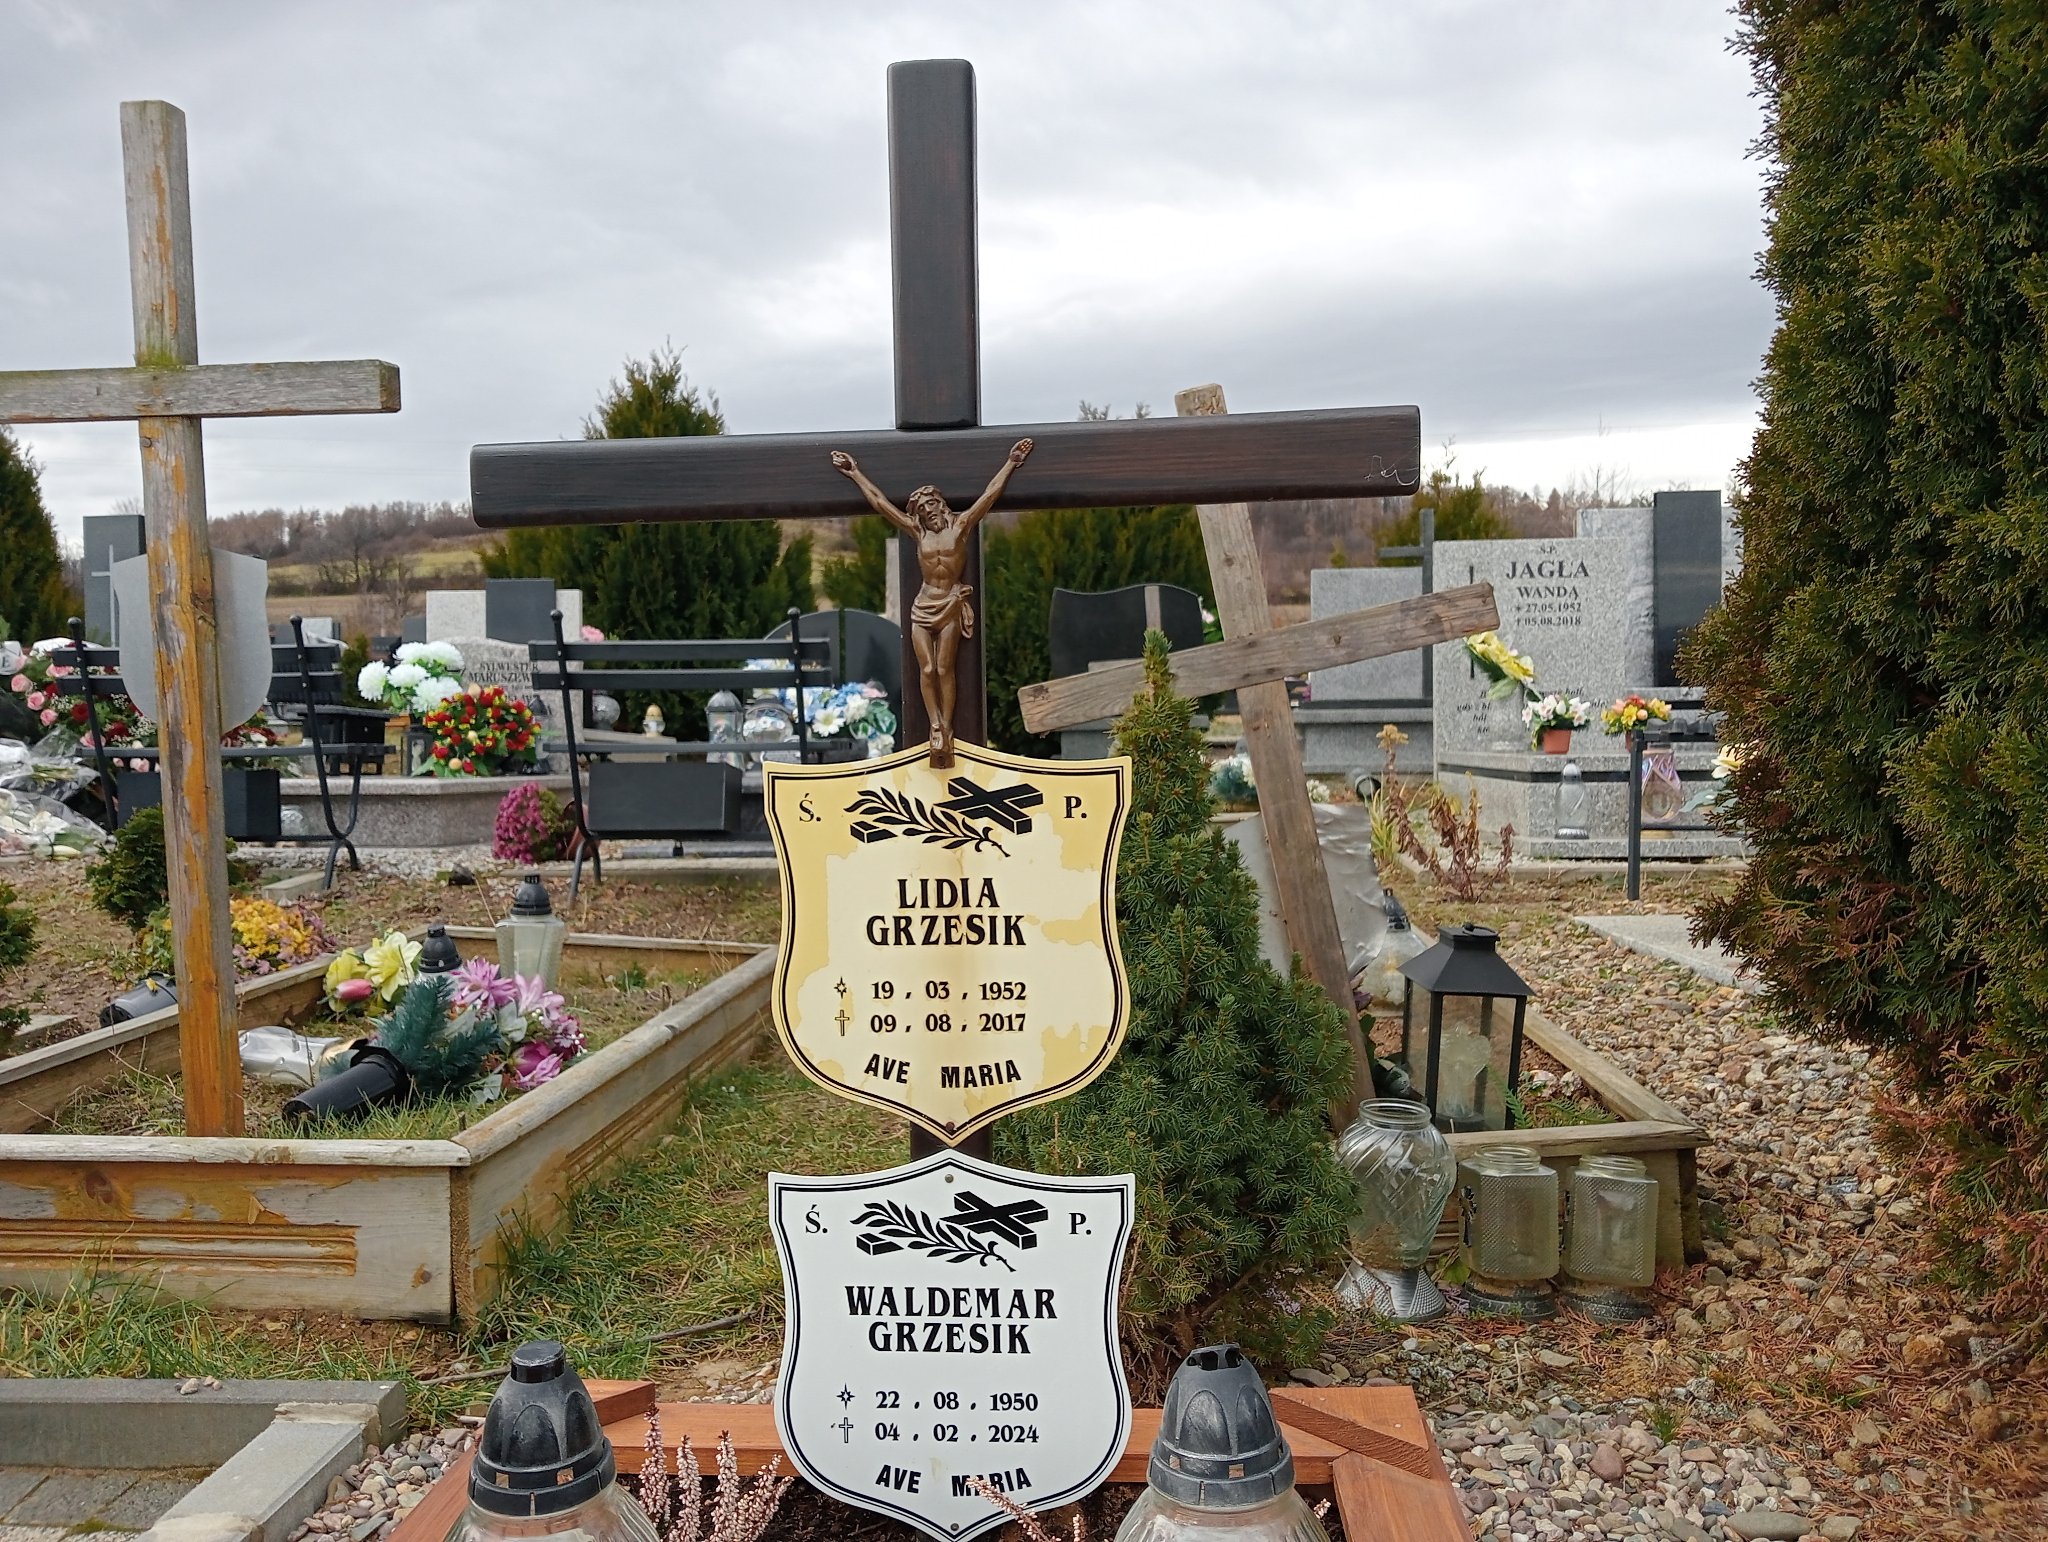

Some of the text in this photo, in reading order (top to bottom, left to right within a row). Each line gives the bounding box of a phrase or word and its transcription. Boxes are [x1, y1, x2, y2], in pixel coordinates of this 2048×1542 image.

[799, 792, 1088, 823] Ś. P.
[897, 877, 1001, 909] LIDIA
[866, 913, 1027, 946] GRZESIK
[871, 980, 895, 1000] 19
[925, 980, 950, 1000] 03
[978, 981, 1027, 1001] 1952
[870, 1014, 897, 1034] 09
[925, 1013, 952, 1033] 08
[979, 1012, 1026, 1032] 2017
[863, 1053, 1022, 1089] AVE MARIA
[805, 1204, 1092, 1236] Ś. P.
[845, 1285, 1058, 1319] WALDEMAR
[868, 1321, 1031, 1354] GRZESIK
[875, 1390, 900, 1409] 22
[933, 1391, 960, 1411] 08
[989, 1392, 1039, 1412] 1950
[874, 1422, 901, 1441] 04
[933, 1423, 959, 1443] 02
[988, 1424, 1040, 1444] 2024
[875, 1464, 922, 1494] AVE
